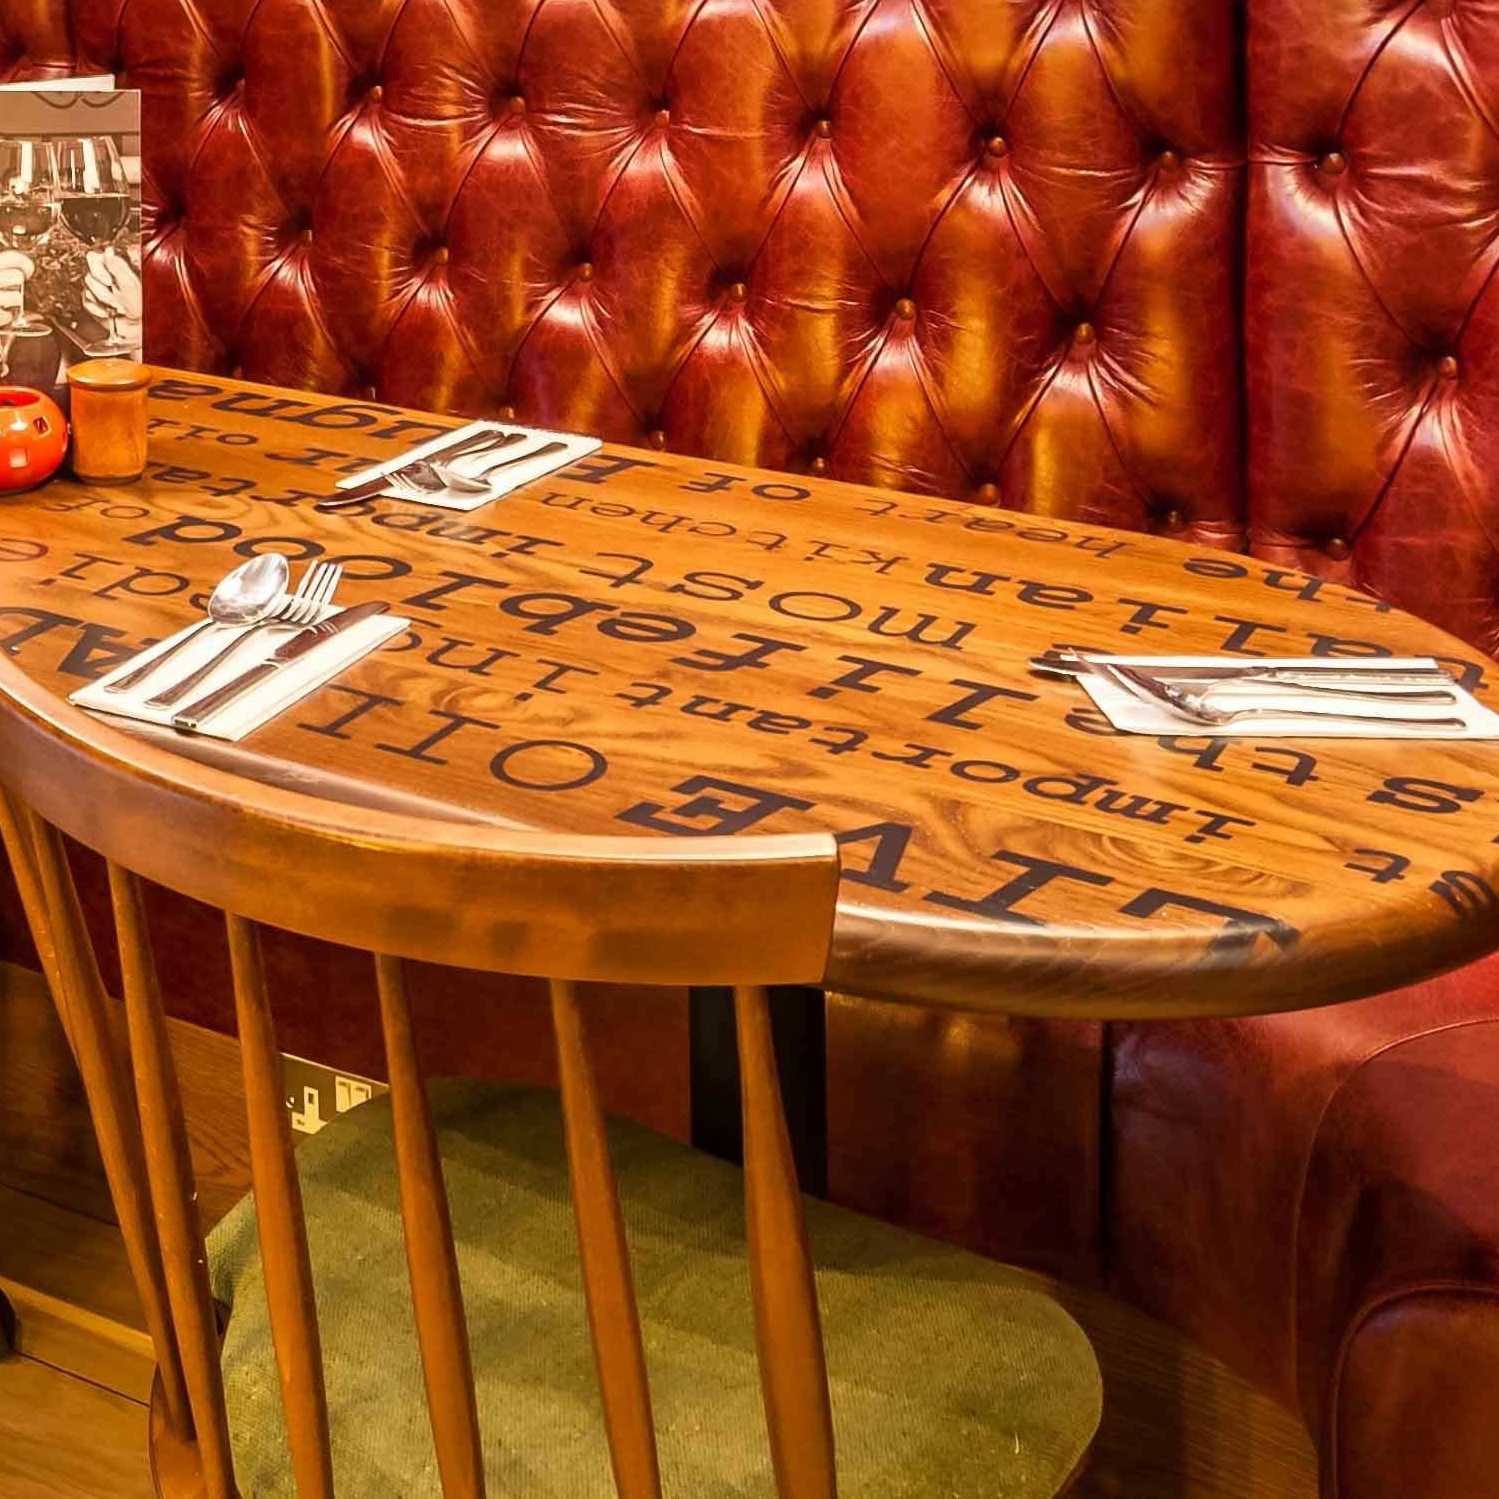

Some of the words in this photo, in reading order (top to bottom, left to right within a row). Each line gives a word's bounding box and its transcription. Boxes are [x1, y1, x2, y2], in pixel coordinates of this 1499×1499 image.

[39, 501, 151, 521] of
[147, 463, 564, 559] importa
[540, 492, 910, 576] kitchen
[677, 472, 812, 503] of
[853, 496, 1136, 559] heart
[122, 515, 1041, 732] lifeblood
[579, 551, 978, 653] most
[614, 681, 1257, 844] important
[614, 779, 1299, 964] LIVE
